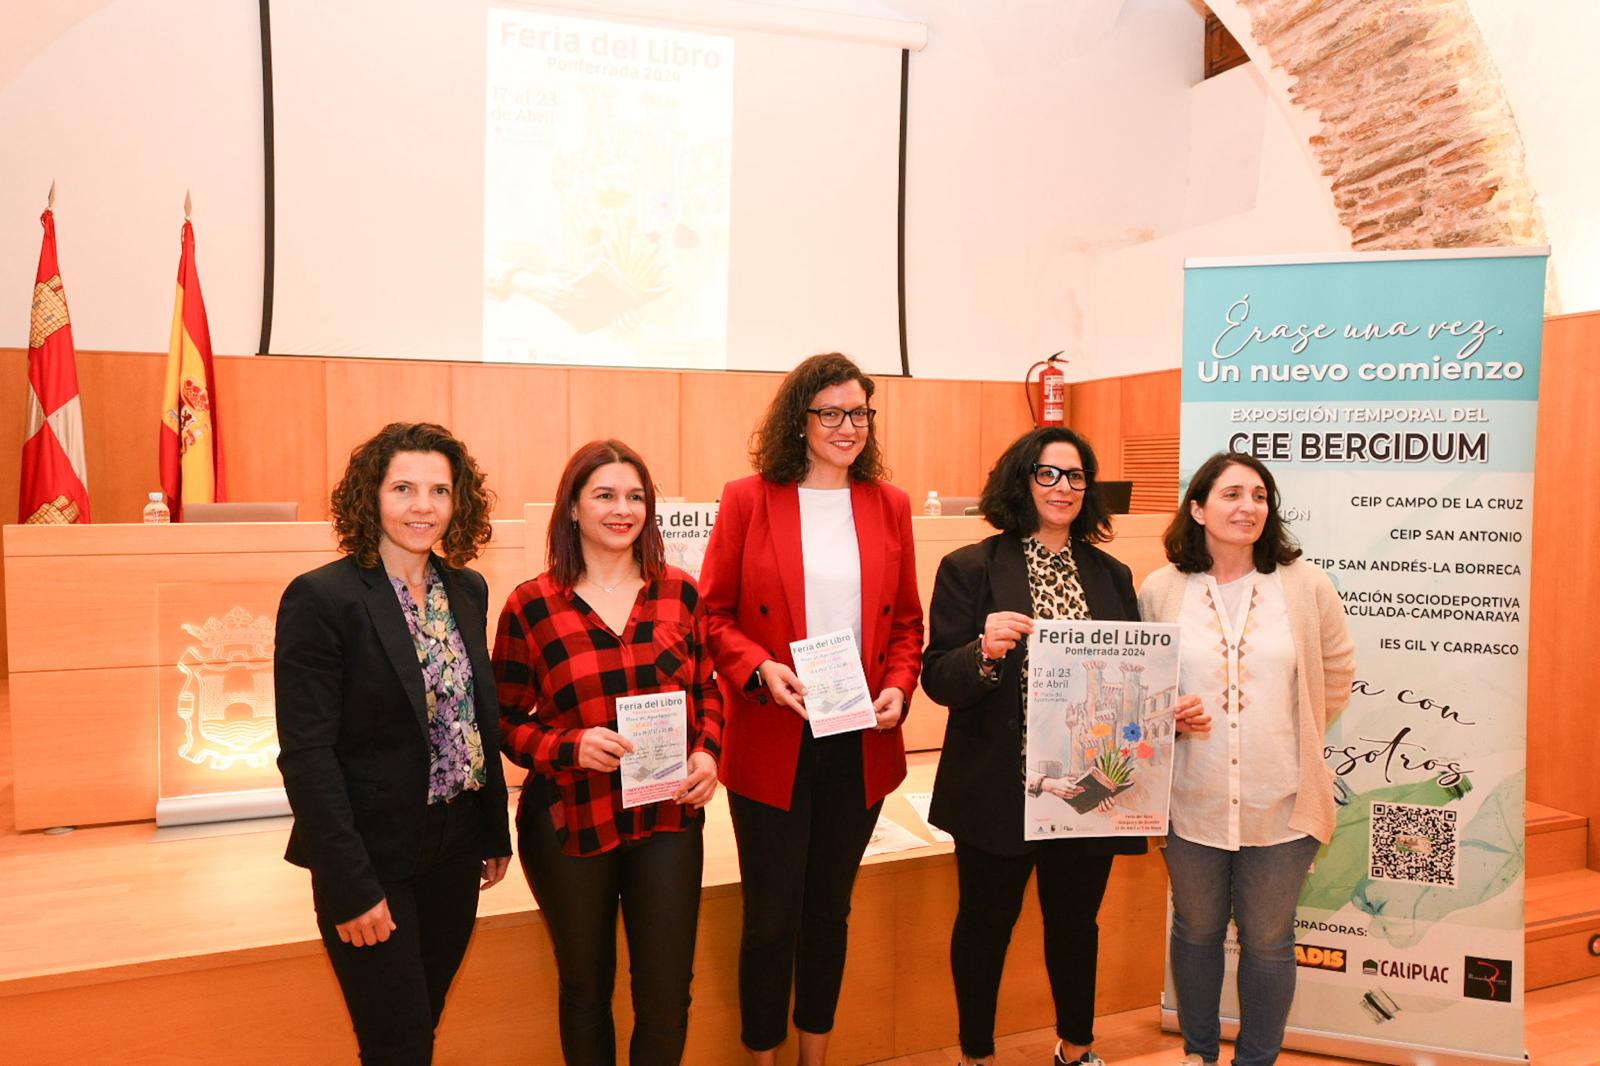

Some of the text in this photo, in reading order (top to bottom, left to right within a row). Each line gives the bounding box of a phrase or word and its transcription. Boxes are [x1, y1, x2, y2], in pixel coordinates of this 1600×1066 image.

[500, 21, 721, 70] Feria del Libro
[545, 56, 681, 83] Ponferrada 2024
[1212, 293, 1505, 360] Érase una vez.
[1197, 354, 1525, 383] Un nuevo comienzo
[1230, 404, 1490, 423] EXPOSICIÓN TEMPORAL DEL
[1228, 431, 1490, 462] CEE BERGIDUM
[1351, 496, 1524, 510] CEIP CAMPO DE LA CRUZ
[670, 511, 699, 527] del
[1282, 507, 1311, 521] IÓN
[662, 529, 700, 539] ferrada
[1390, 528, 1522, 543] CEIP SAN ANTONIO
[1339, 559, 1367, 571] SAN
[1370, 558, 1451, 574] ANDRÉS-LA
[1455, 562, 1522, 576] BORRECA
[1338, 589, 1521, 609] MACIÓN SOCIODEPORTIVA
[1344, 605, 1520, 623] ACULADA-CAMPONARAYA
[793, 642, 815, 654] Feria
[815, 640, 829, 649] del
[830, 634, 851, 646] Libro
[1039, 628, 1172, 647] Feria del Libro
[1065, 646, 1146, 657] Ponferrada 2024
[1380, 638, 1519, 656] IES GIL Y CARRASCO
[1033, 667, 1072, 678] 17 al 23
[1032, 679, 1069, 689] de Abril
[619, 698, 683, 711] Feria del Libro
[1397, 689, 1476, 726] con
[1324, 727, 1475, 787] osotros
[1295, 945, 1345, 969] ADIS
